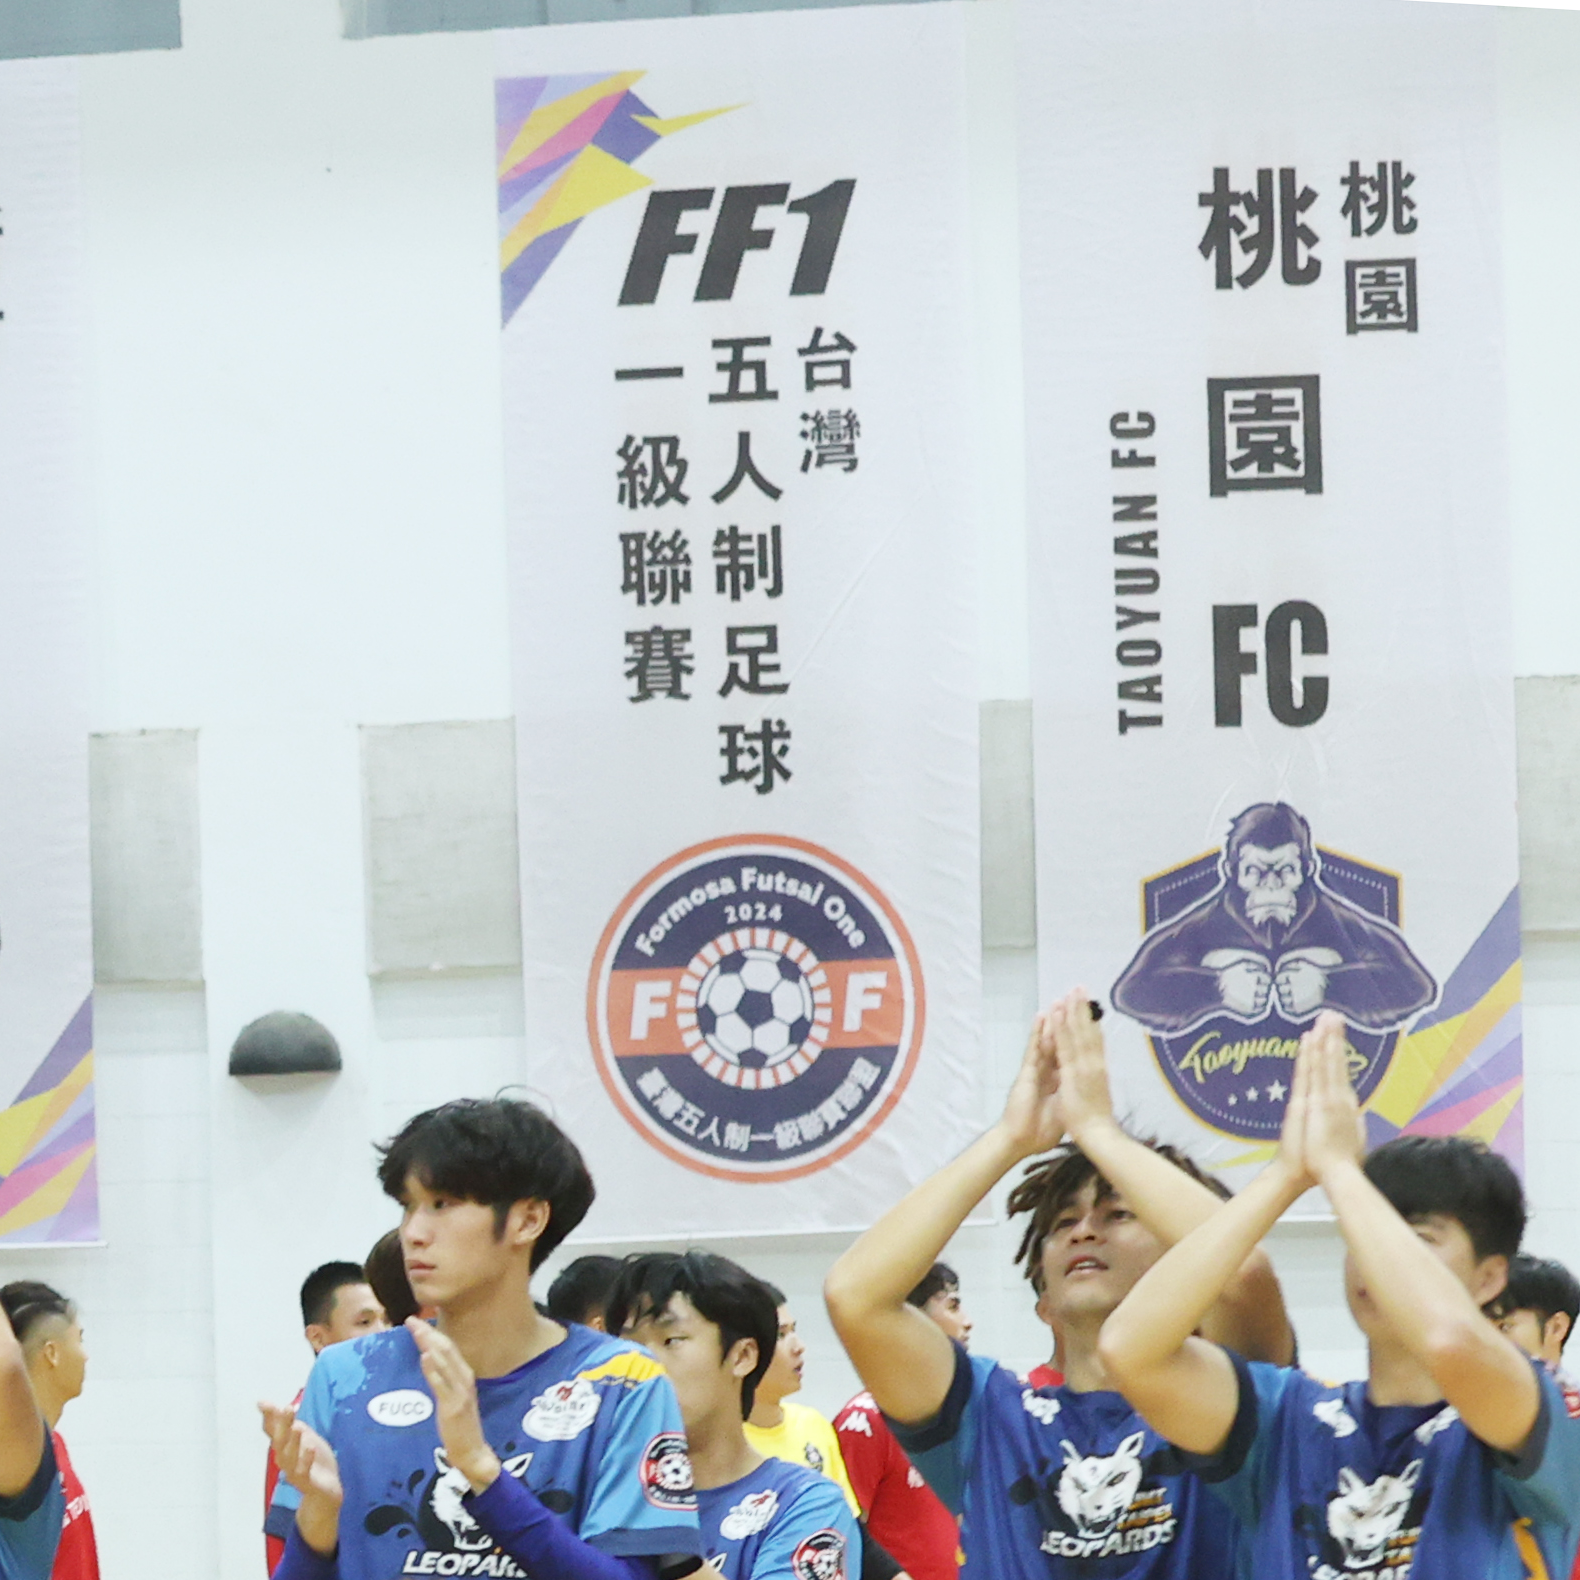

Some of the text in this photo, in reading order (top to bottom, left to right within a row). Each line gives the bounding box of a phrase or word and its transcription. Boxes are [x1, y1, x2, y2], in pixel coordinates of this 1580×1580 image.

[616, 178, 857, 307] FF1
[1340, 160, 1418, 336] 桃園
[797, 326, 860, 473] 台灣
[1198, 167, 1329, 728] 桃園 FC
[614, 365, 695, 704] 一級聯賽
[708, 335, 793, 795] 五人制足球
[1110, 410, 1163, 735] TAOYUAN FC
[635, 867, 866, 957] Formosa Futsal One
[725, 903, 782, 924] 2024
[402, 1551, 528, 1579] LEOPA
